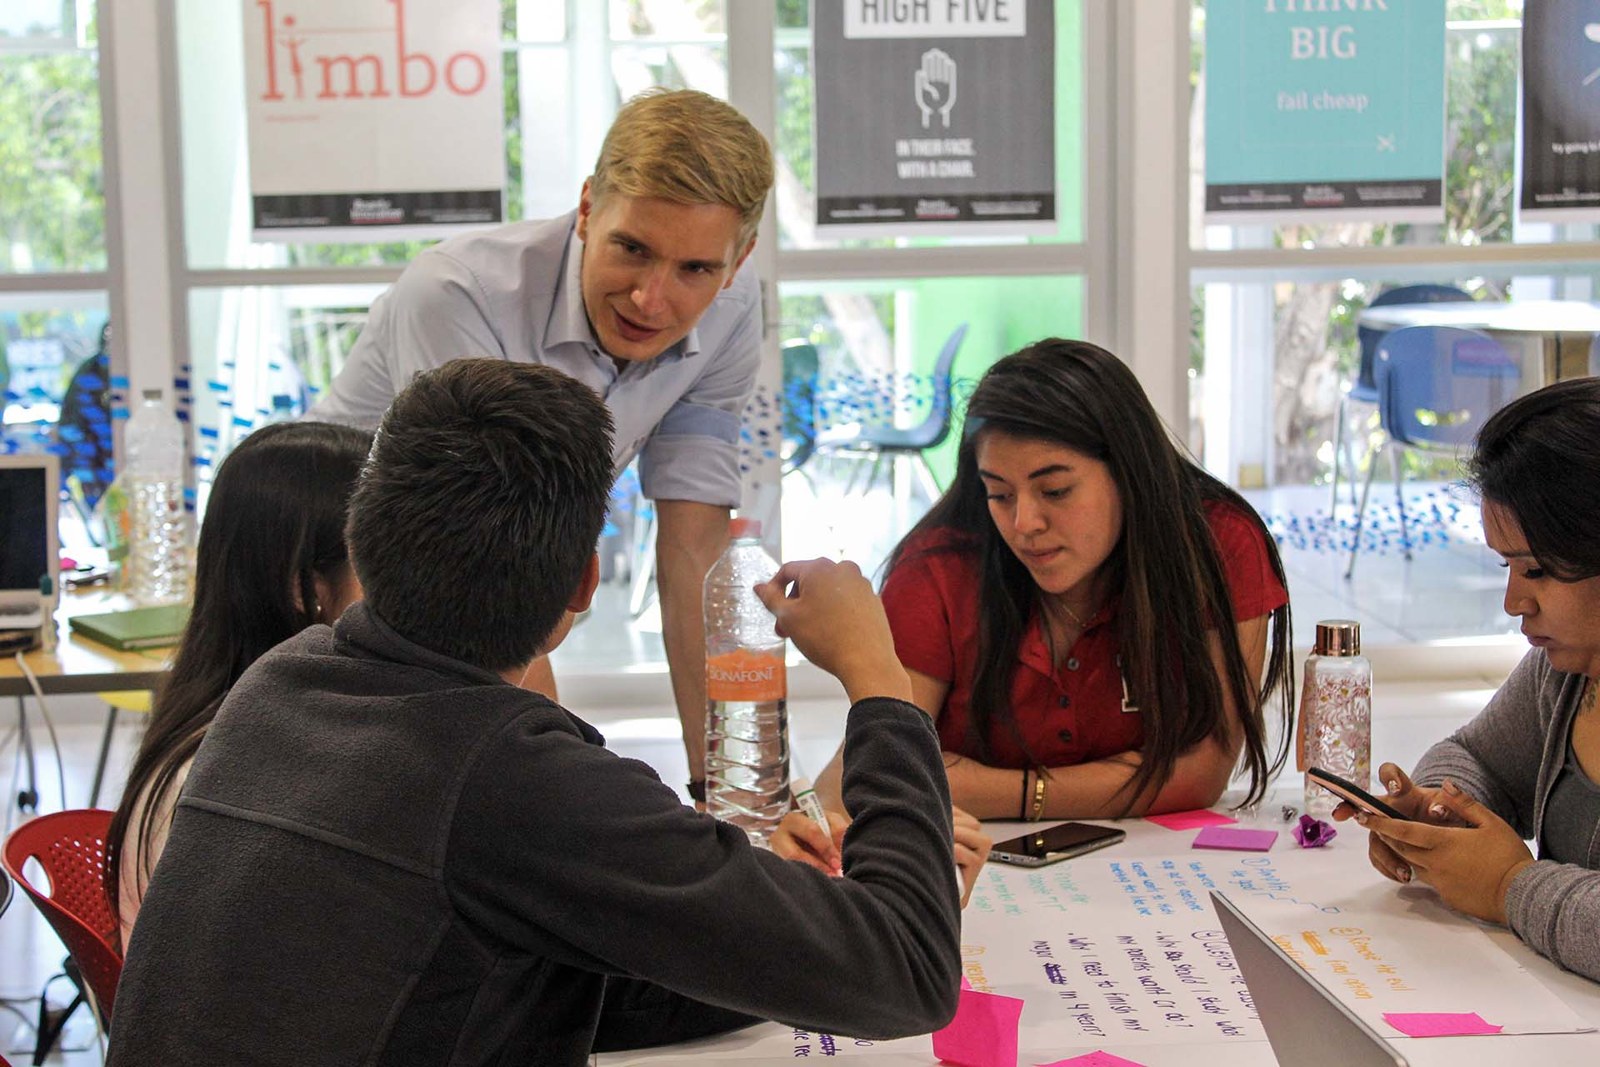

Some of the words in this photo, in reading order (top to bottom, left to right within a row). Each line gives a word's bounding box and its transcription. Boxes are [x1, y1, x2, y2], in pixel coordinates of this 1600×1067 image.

[861, 0, 930, 24] HIGH
[947, 0, 1009, 23] FIVE
[258, 0, 488, 101] limbo
[1291, 26, 1357, 60] BIG
[1277, 90, 1309, 111] fail
[1312, 88, 1370, 114] cheap
